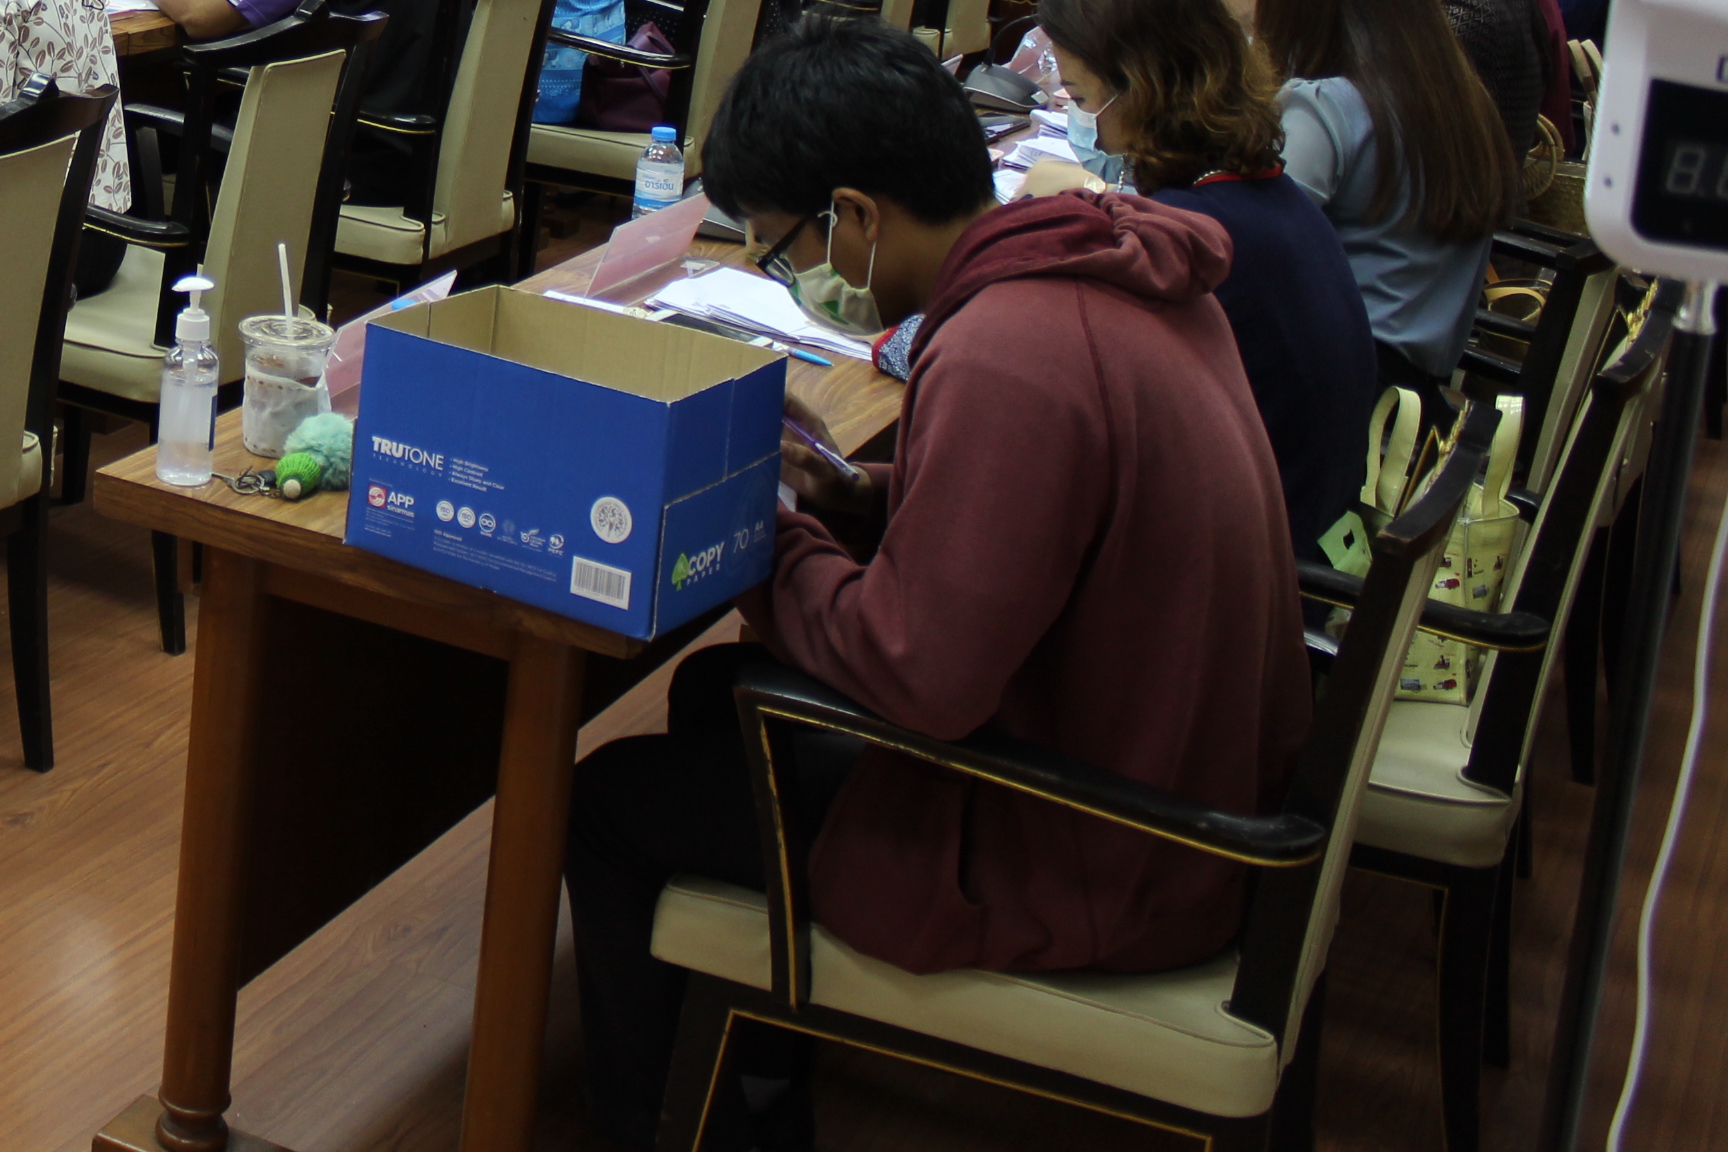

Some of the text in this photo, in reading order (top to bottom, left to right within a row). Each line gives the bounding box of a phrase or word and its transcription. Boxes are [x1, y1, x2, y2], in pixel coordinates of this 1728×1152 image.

[372, 436, 444, 471] TRUTONE
[388, 491, 414, 508] APP
[734, 529, 749, 553] 70
[688, 541, 725, 576] COPY
